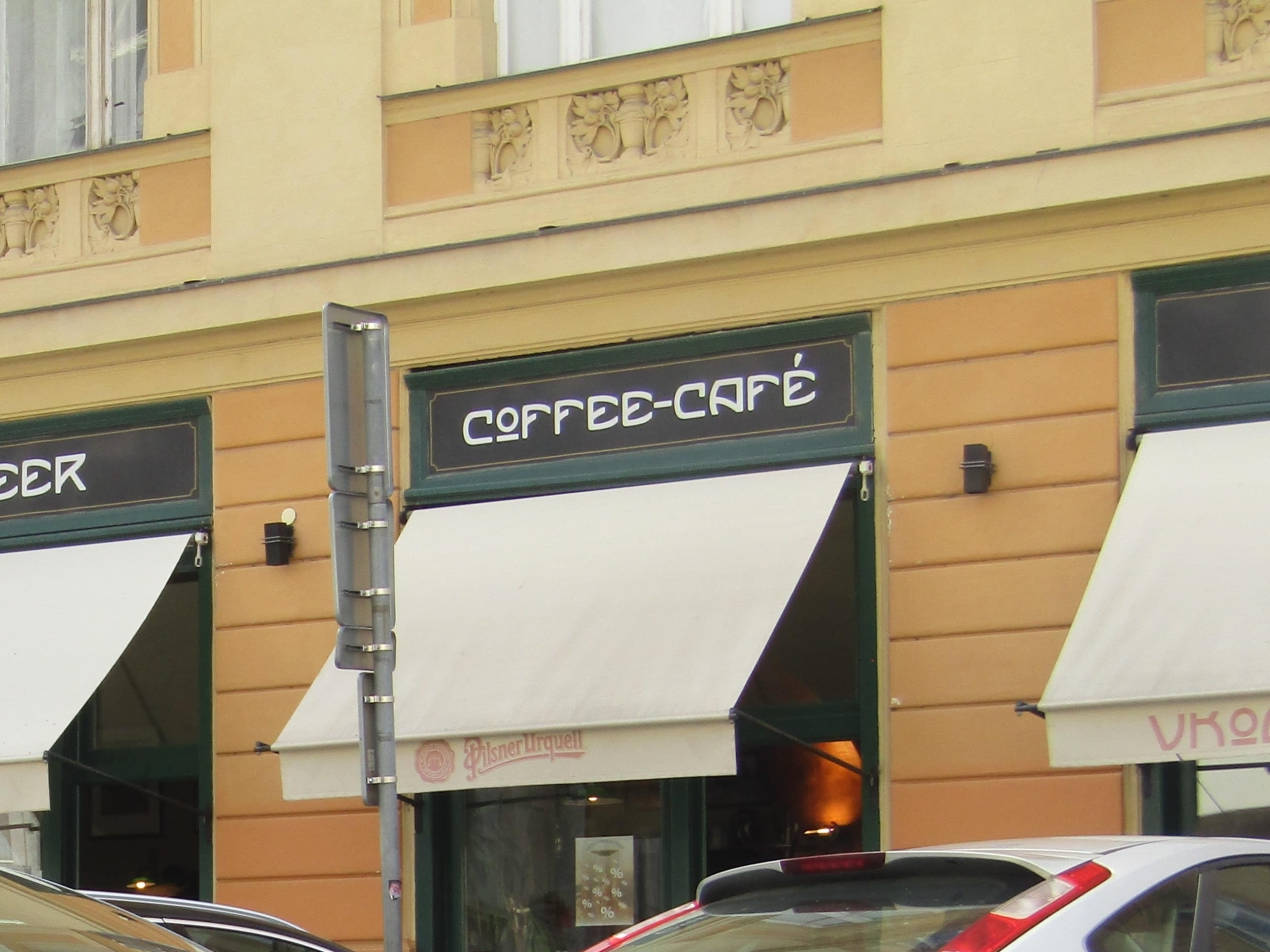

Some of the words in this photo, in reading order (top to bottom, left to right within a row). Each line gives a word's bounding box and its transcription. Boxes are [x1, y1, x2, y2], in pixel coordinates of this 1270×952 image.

[462, 352, 816, 446] COFFEE-CAFÉ
[463, 736, 523, 781] Pilsner
[522, 729, 583, 762] Urquell
